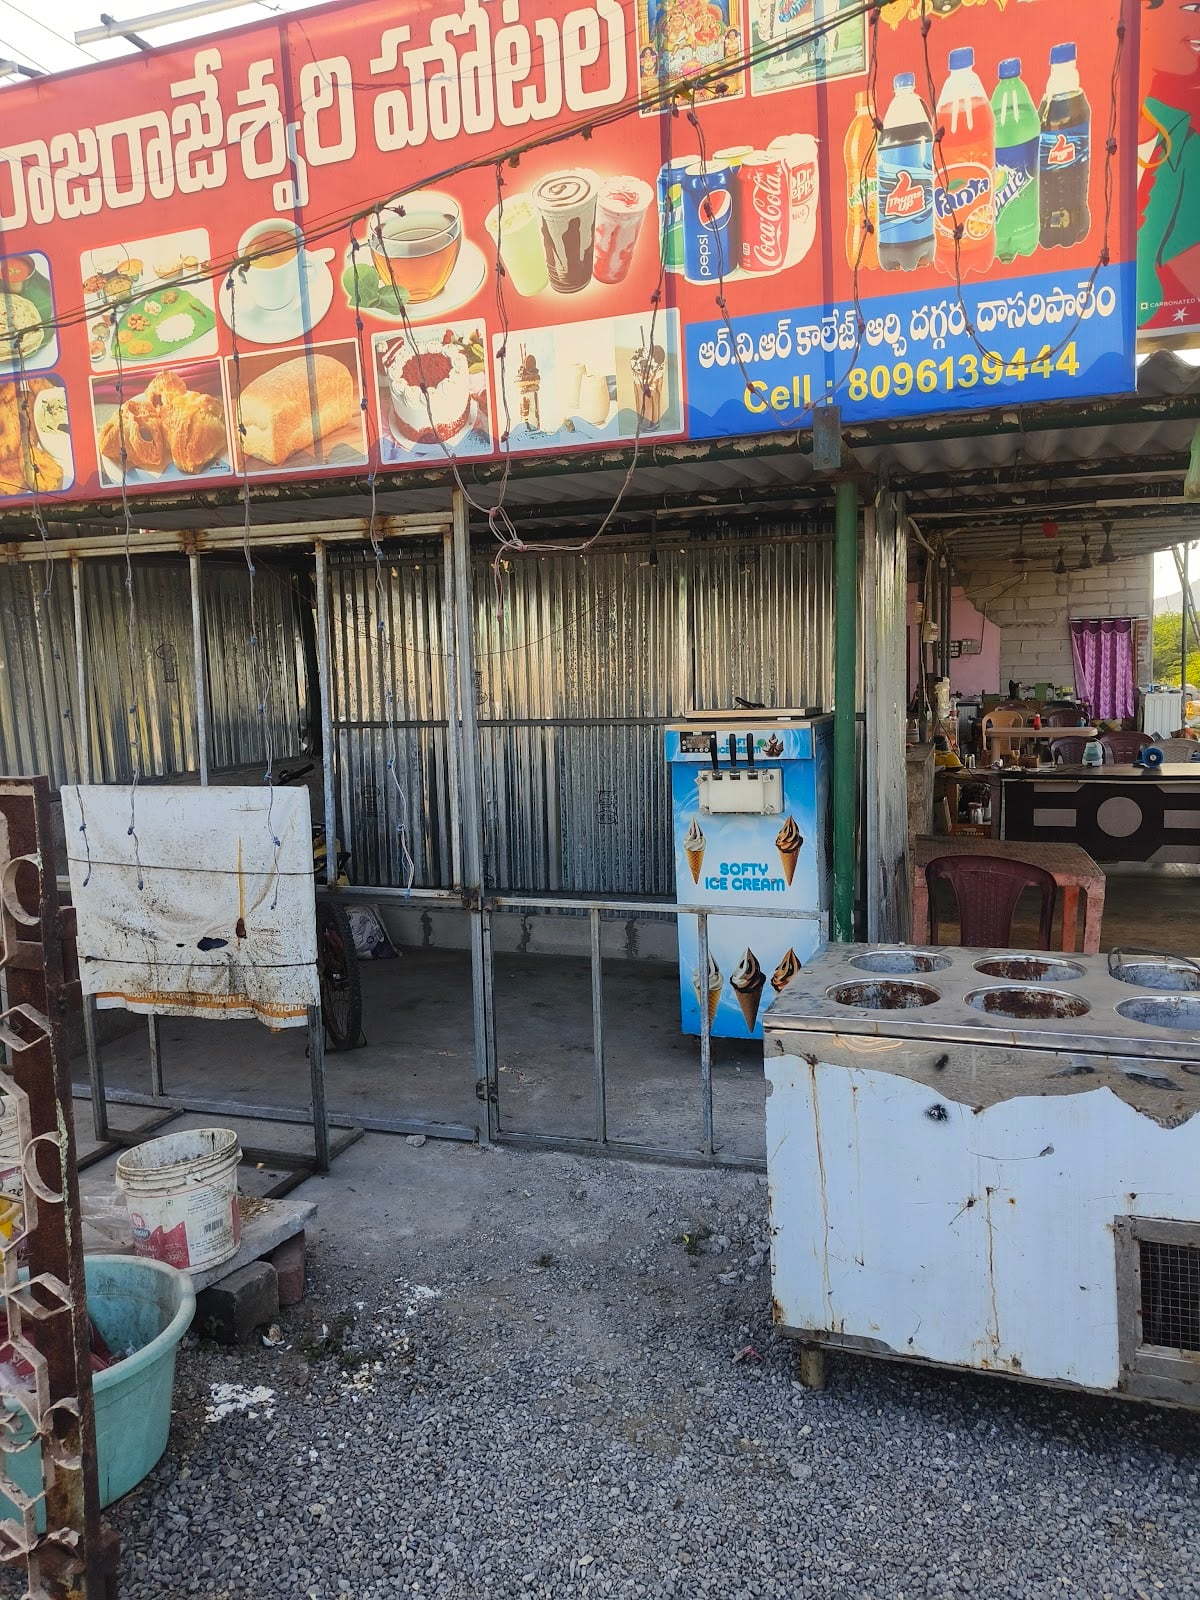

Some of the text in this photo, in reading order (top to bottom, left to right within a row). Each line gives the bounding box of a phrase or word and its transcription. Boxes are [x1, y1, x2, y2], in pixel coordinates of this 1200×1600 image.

[934, 177, 989, 218] Fanta
[994, 171, 1025, 217] prite
[697, 234, 711, 276] pepsi
[1150, 298, 1196, 308] CARBONATED
[743, 374, 811, 414] Cell
[848, 341, 1080, 402] 8096139444
[705, 877, 785, 892] ICE CREAM
[719, 863, 769, 877] SOFTY
